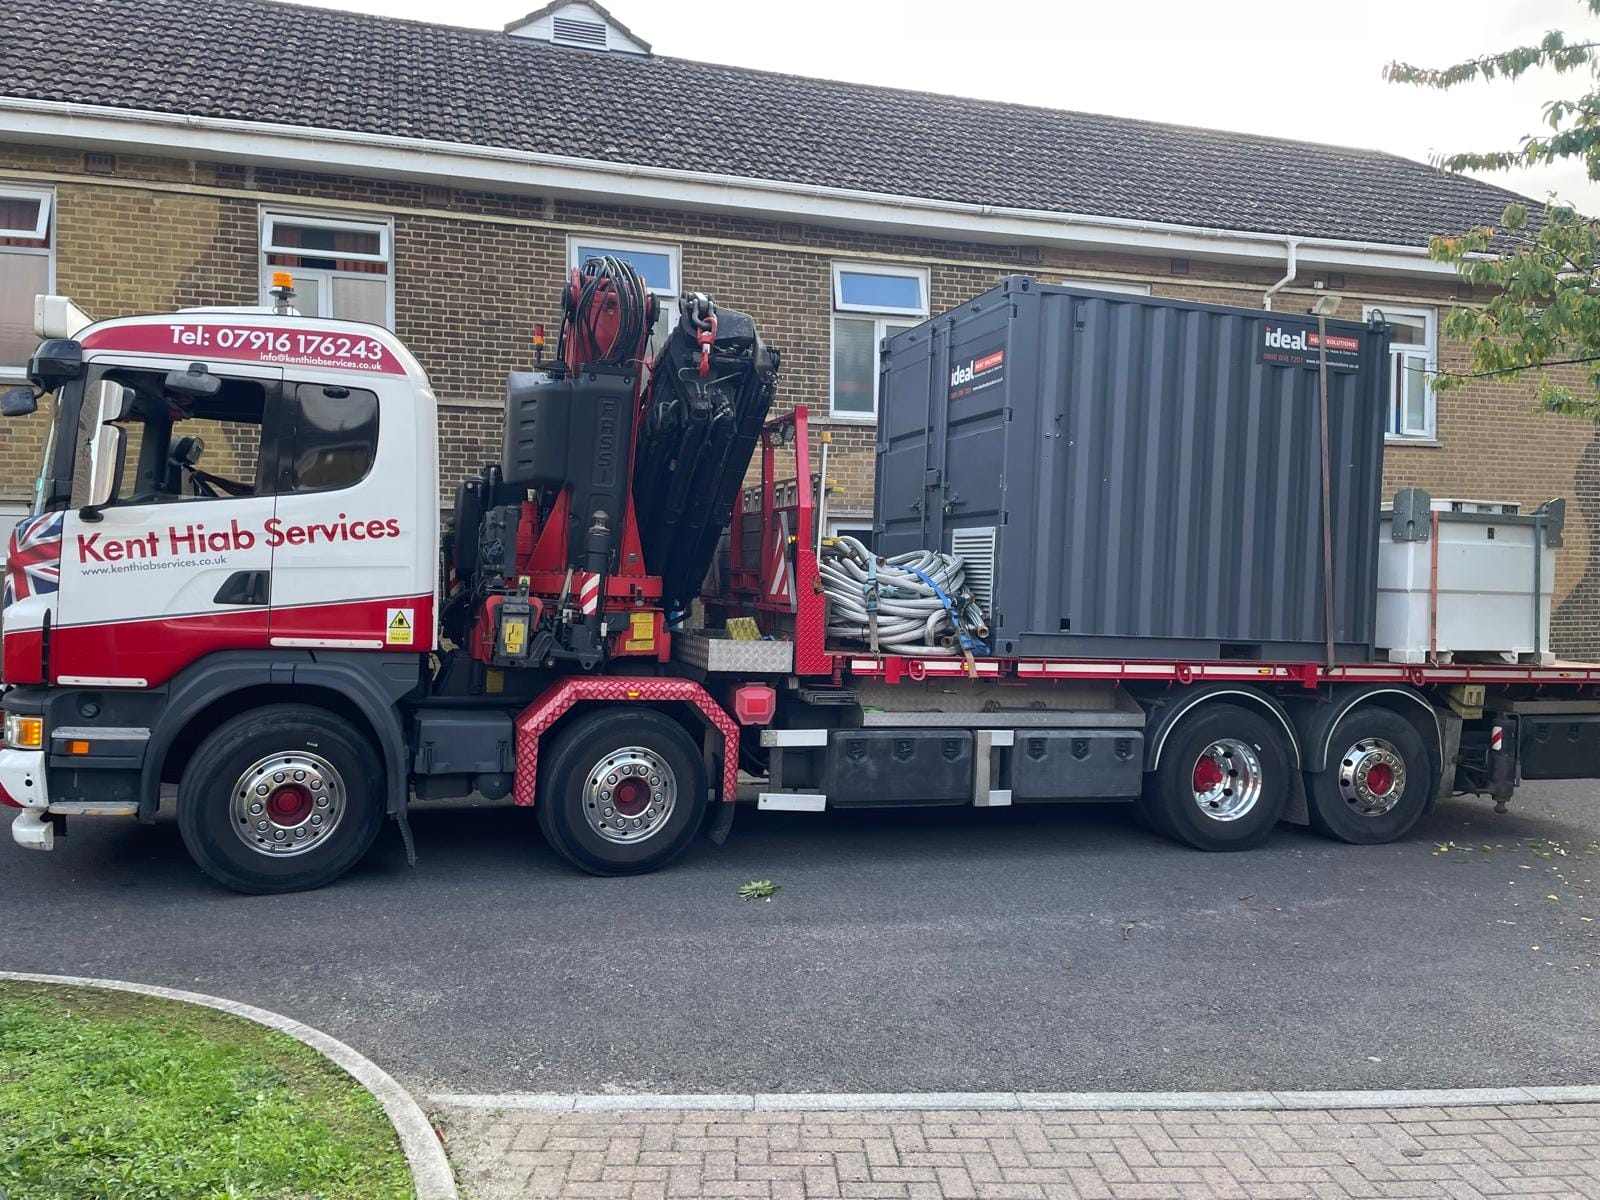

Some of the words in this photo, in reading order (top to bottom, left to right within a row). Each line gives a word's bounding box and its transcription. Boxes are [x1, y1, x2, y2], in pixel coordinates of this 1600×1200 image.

[170, 325, 210, 346] Tel:
[216, 328, 291, 352] 07916
[297, 334, 383, 360] 176243
[1264, 326, 1307, 351] ideal
[1326, 338, 1356, 348] SOLUTIONS
[260, 352, 382, 371] info@kenthiabservices.co.uk
[951, 360, 974, 387] ideal
[77, 532, 159, 564] Kent
[168, 519, 255, 556] Hiab
[264, 513, 400, 547] Services
[81, 555, 228, 576] www.kenthiabservices.co.uk
